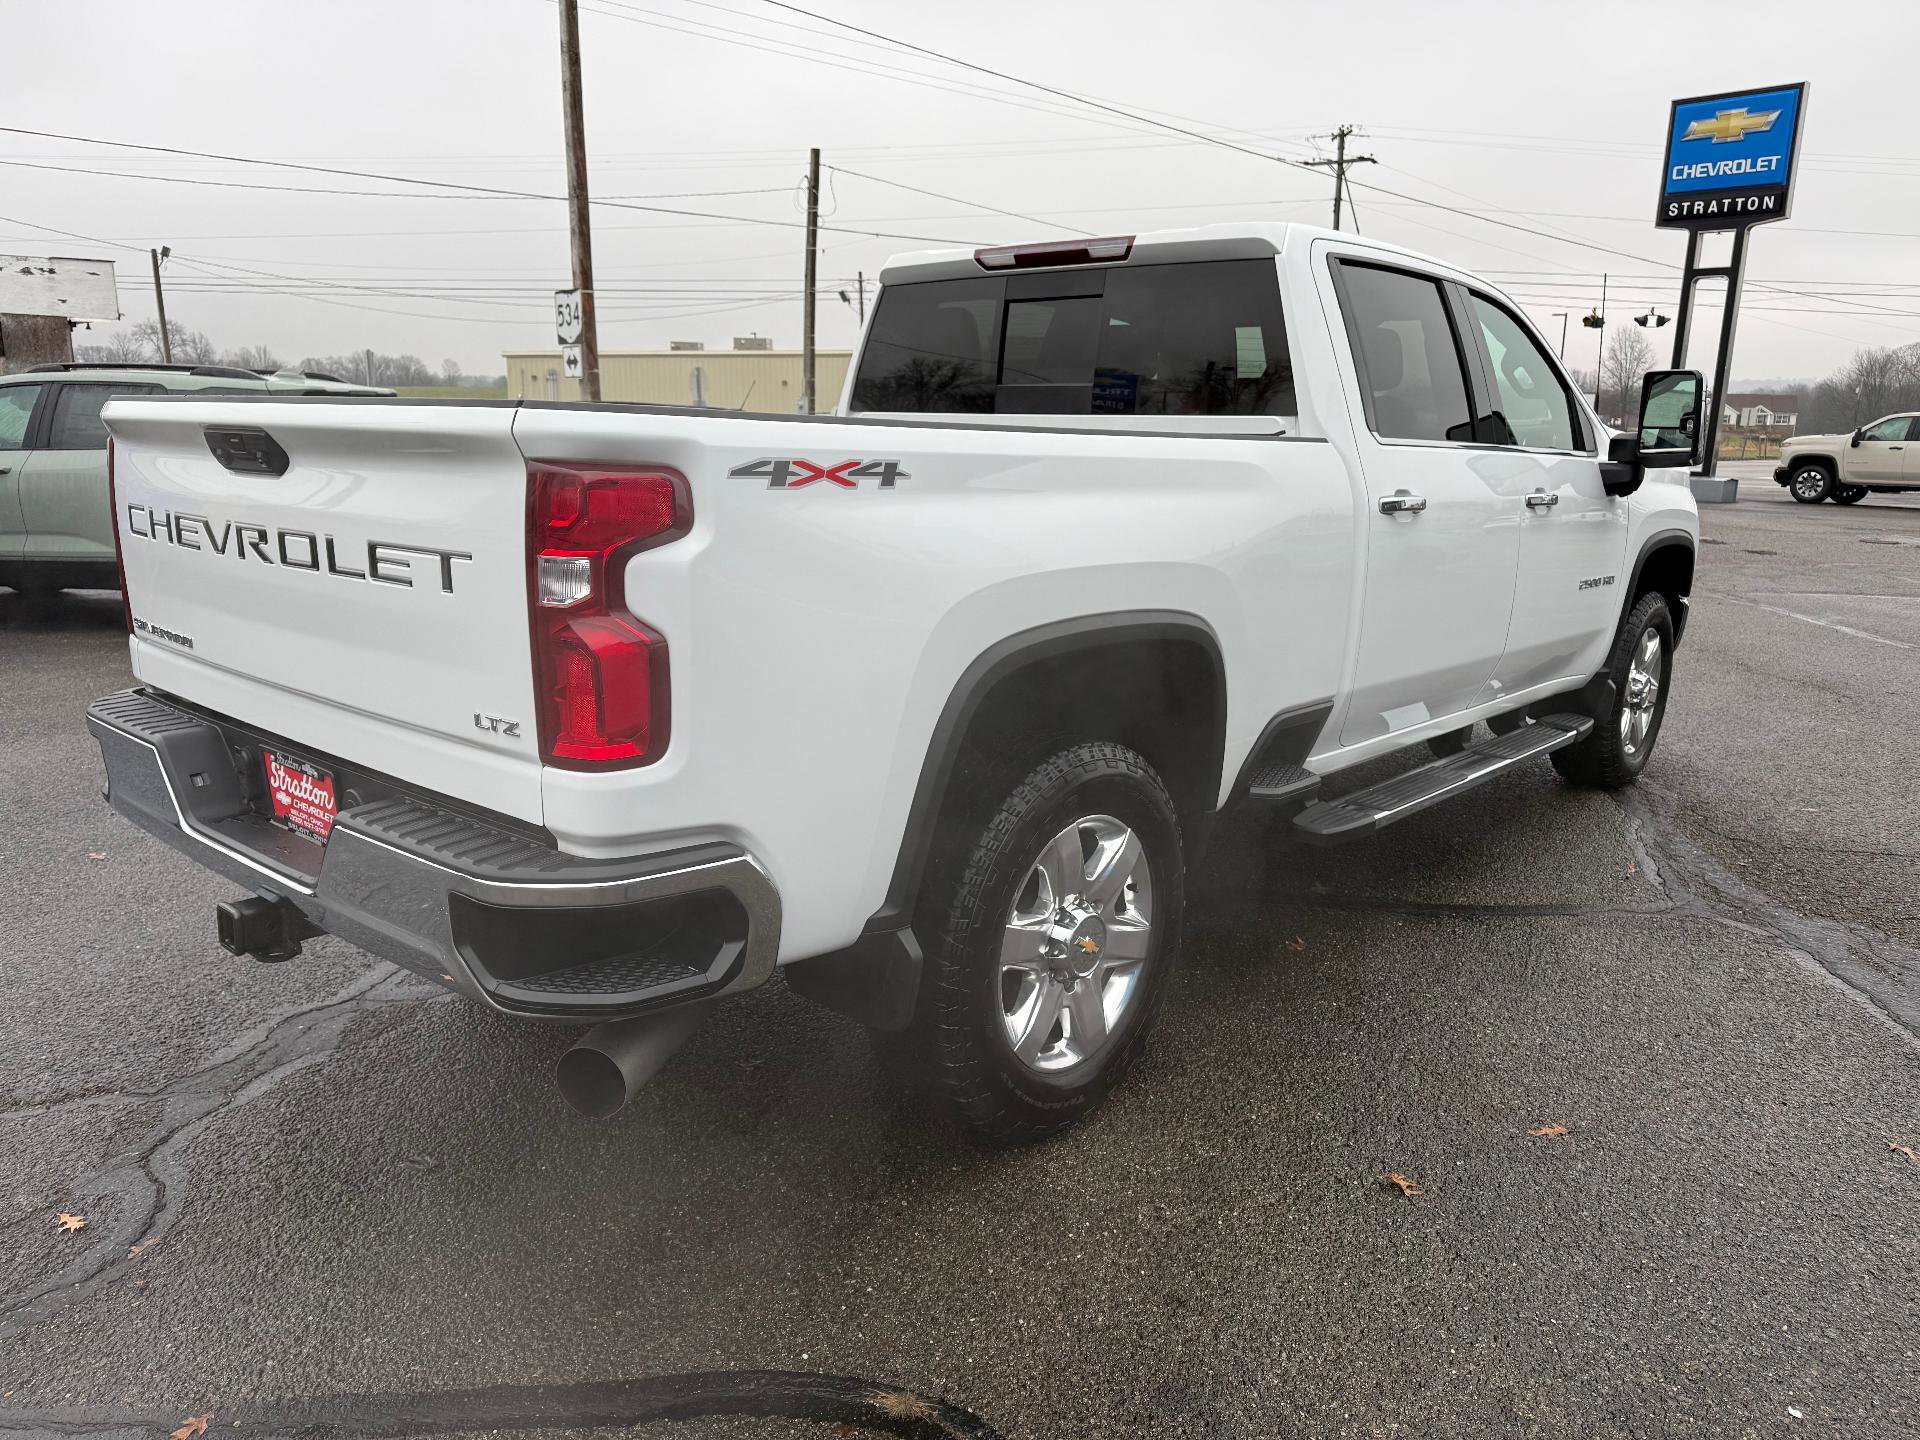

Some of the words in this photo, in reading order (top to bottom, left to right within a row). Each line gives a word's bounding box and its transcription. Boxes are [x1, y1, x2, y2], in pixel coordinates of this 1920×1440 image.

[1672, 155, 1782, 181] CHEVROLET
[1668, 195, 1776, 217] STRATTON
[557, 301, 581, 328] 534
[127, 503, 474, 594] CHEVROLET
[473, 712, 521, 738] LTZ
[270, 761, 335, 810] Stratton
[293, 798, 335, 824] CHEVROLET
